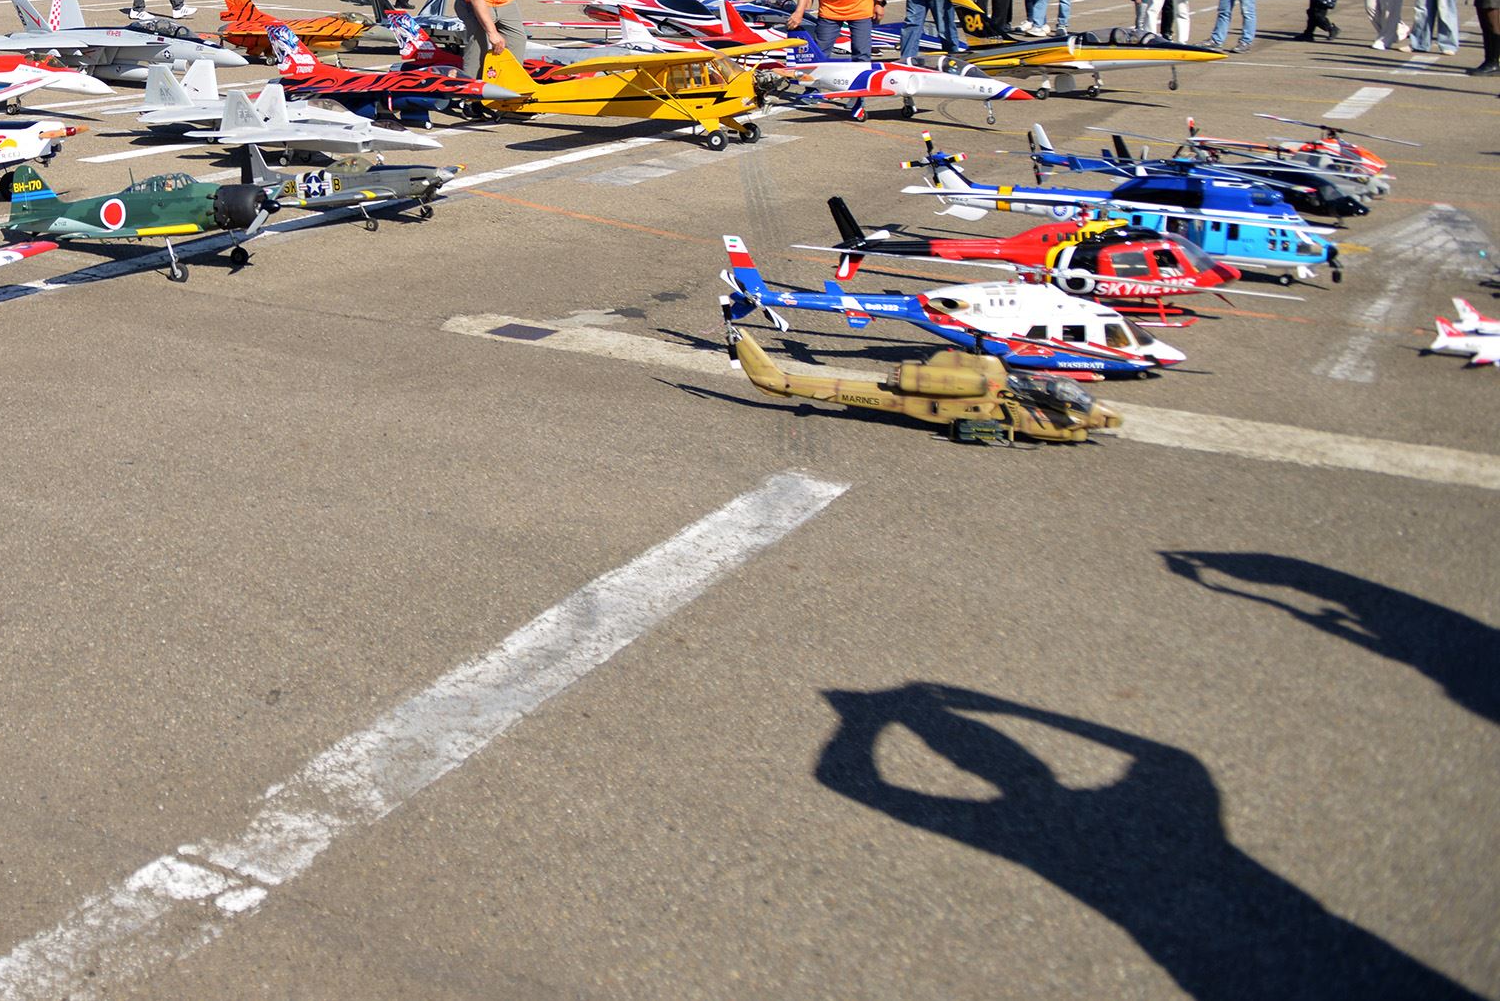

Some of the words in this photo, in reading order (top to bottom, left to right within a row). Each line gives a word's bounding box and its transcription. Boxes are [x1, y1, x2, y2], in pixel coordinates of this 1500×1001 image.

[964, 13, 984, 32] 84
[13, 179, 42, 193] BH-170
[1095, 278, 1197, 296] SKYNEWS
[1057, 360, 1105, 370] MASERATI
[842, 393, 880, 406] MARINES
